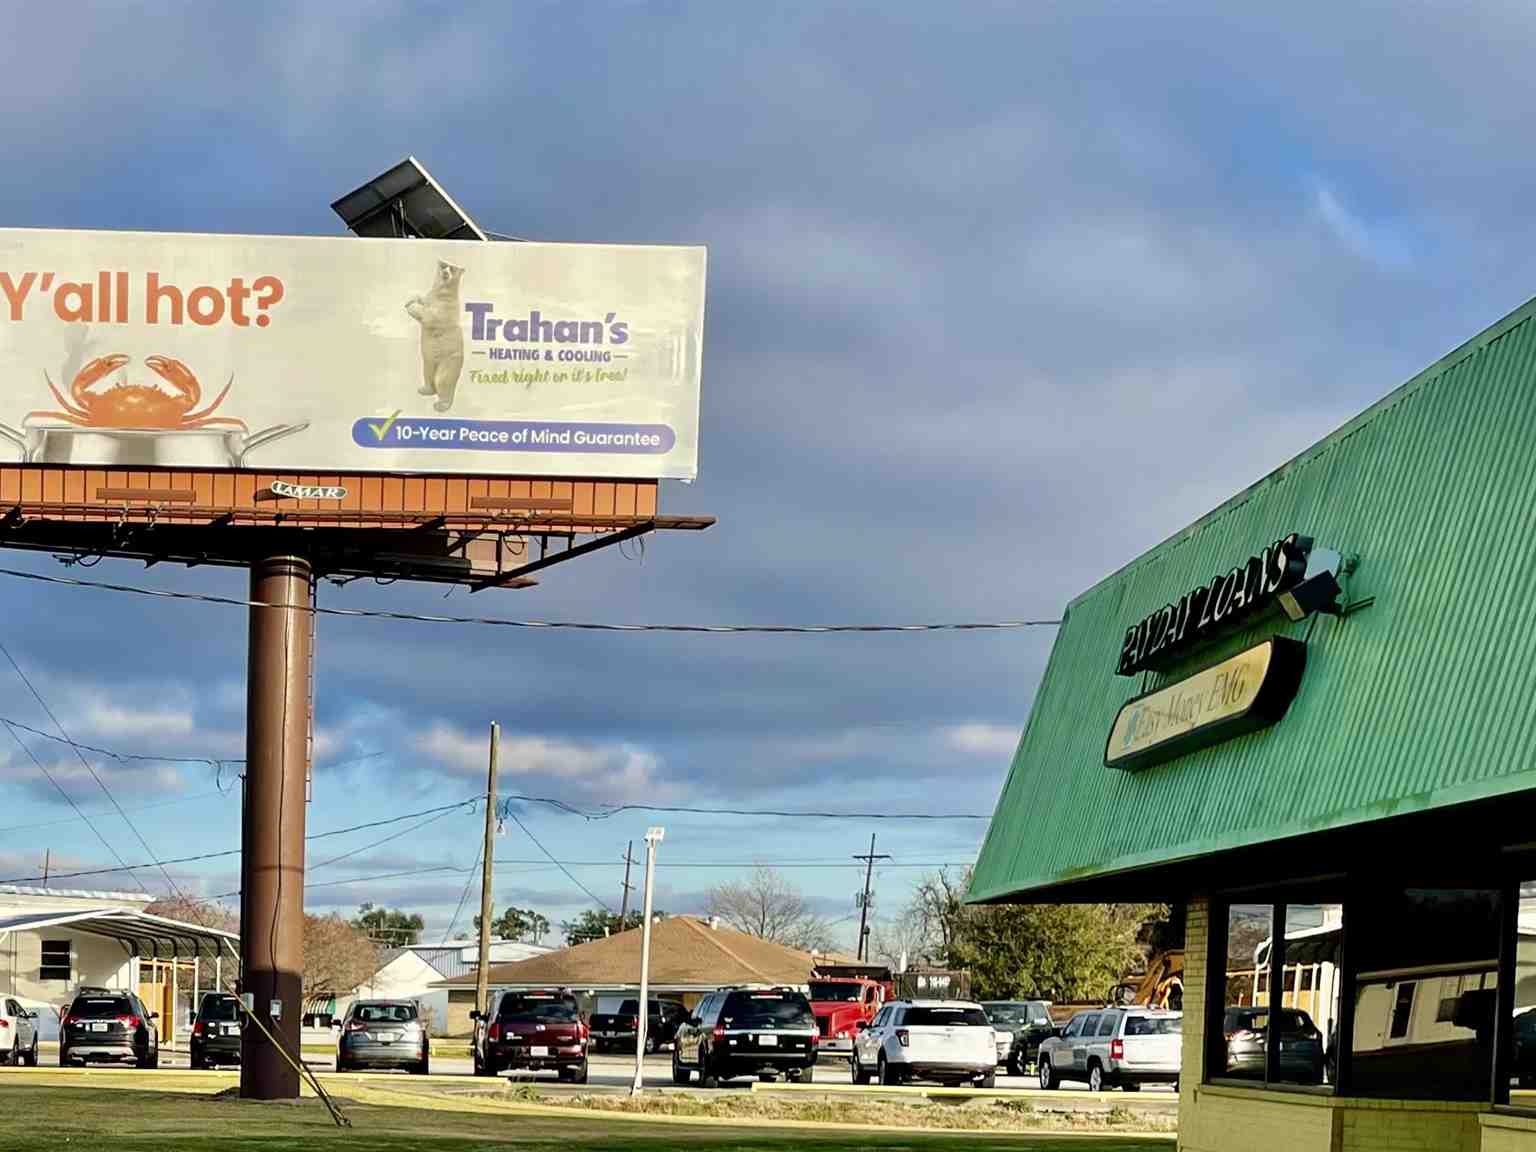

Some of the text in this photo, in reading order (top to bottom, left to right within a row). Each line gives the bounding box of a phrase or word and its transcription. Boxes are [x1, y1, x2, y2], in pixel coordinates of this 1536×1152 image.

[145, 270, 285, 329] hot?
[465, 302, 630, 345] Trahan's
[489, 347, 612, 363] HEATING & COOLING
[469, 369, 508, 385] Fixed
[511, 368, 550, 390] right
[553, 371, 569, 384] or
[395, 425, 661, 447] 10-Year Peace of Mind Guarantee
[275, 482, 340, 499] LAMAR
[1119, 533, 1302, 672] PAYDAY LOANS
